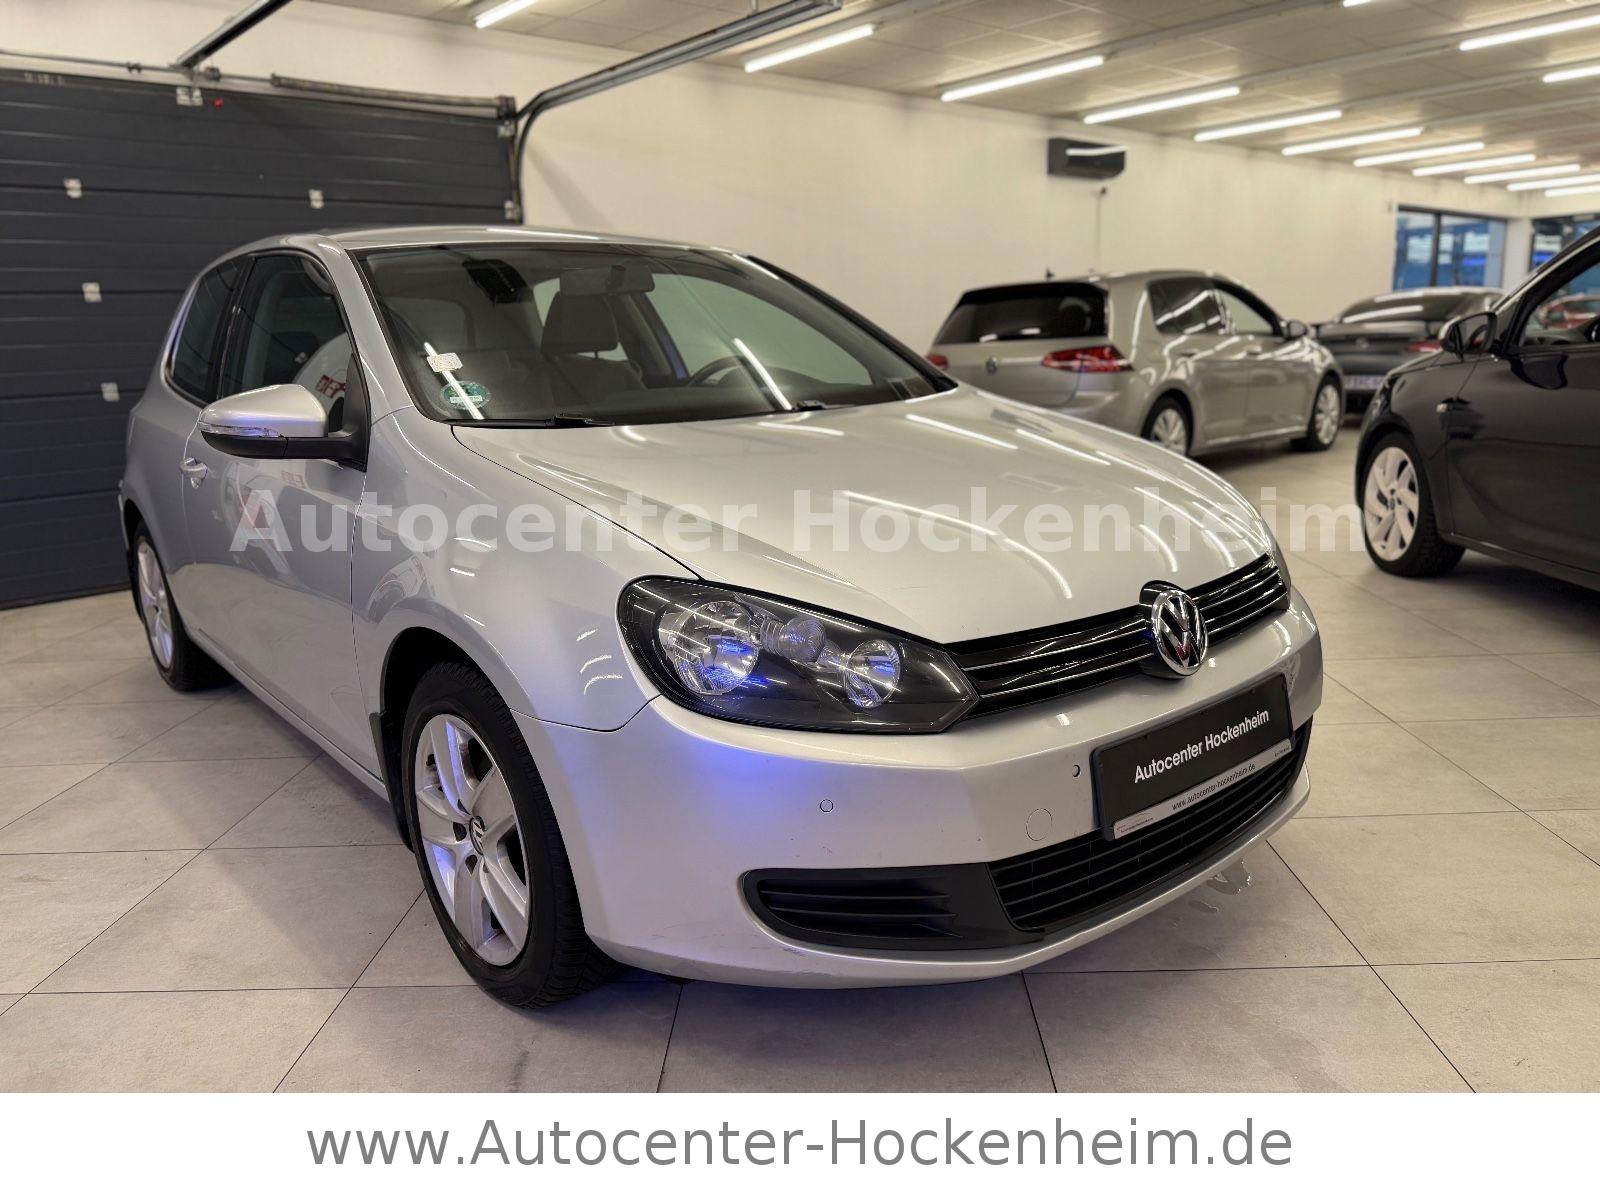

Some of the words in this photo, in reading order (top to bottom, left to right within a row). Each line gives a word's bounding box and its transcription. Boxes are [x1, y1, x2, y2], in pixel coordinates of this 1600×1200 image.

[1134, 741, 1203, 784] Autocenter
[1205, 709, 1270, 752] Hockenheim
[1171, 763, 1256, 811] www.autocenter-hockenheim.de
